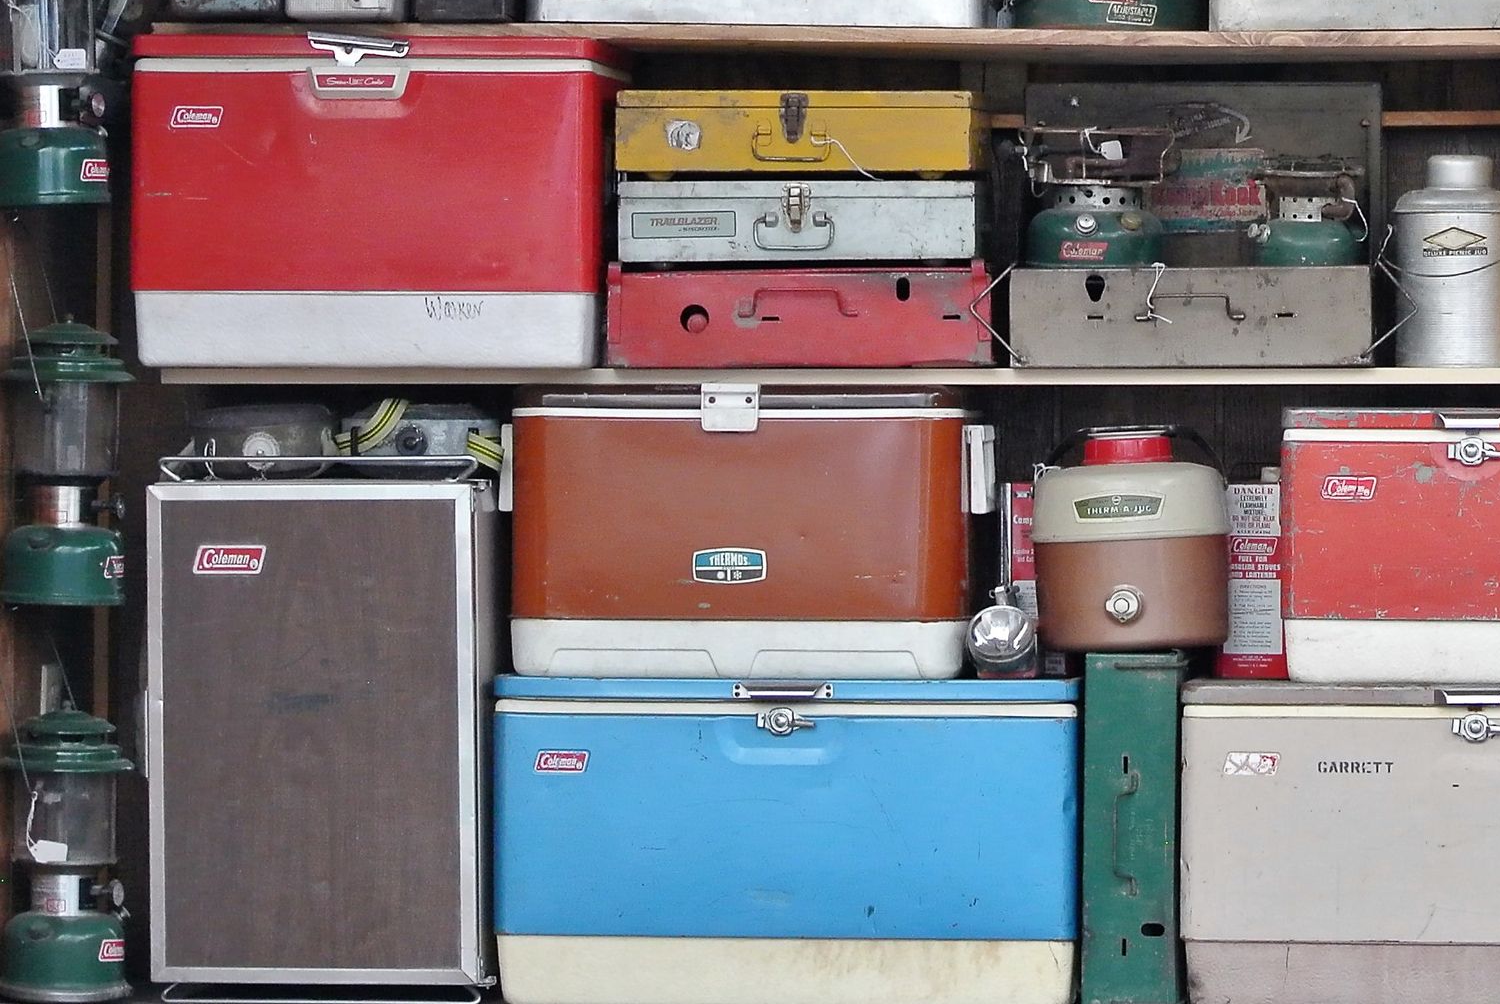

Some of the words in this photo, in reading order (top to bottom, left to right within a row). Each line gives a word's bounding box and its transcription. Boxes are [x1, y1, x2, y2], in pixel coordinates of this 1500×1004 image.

[177, 108, 213, 124] Coleman
[650, 216, 718, 227] TRAILBLAZER
[1234, 487, 1274, 495] DANGER
[1327, 478, 1365, 494] Coleman
[1233, 538, 1268, 553] Coleman
[203, 548, 250, 569] Coleman
[709, 552, 748, 566] THERMOS
[540, 752, 577, 769] Coleman
[1317, 761, 1394, 774] GARRETT
